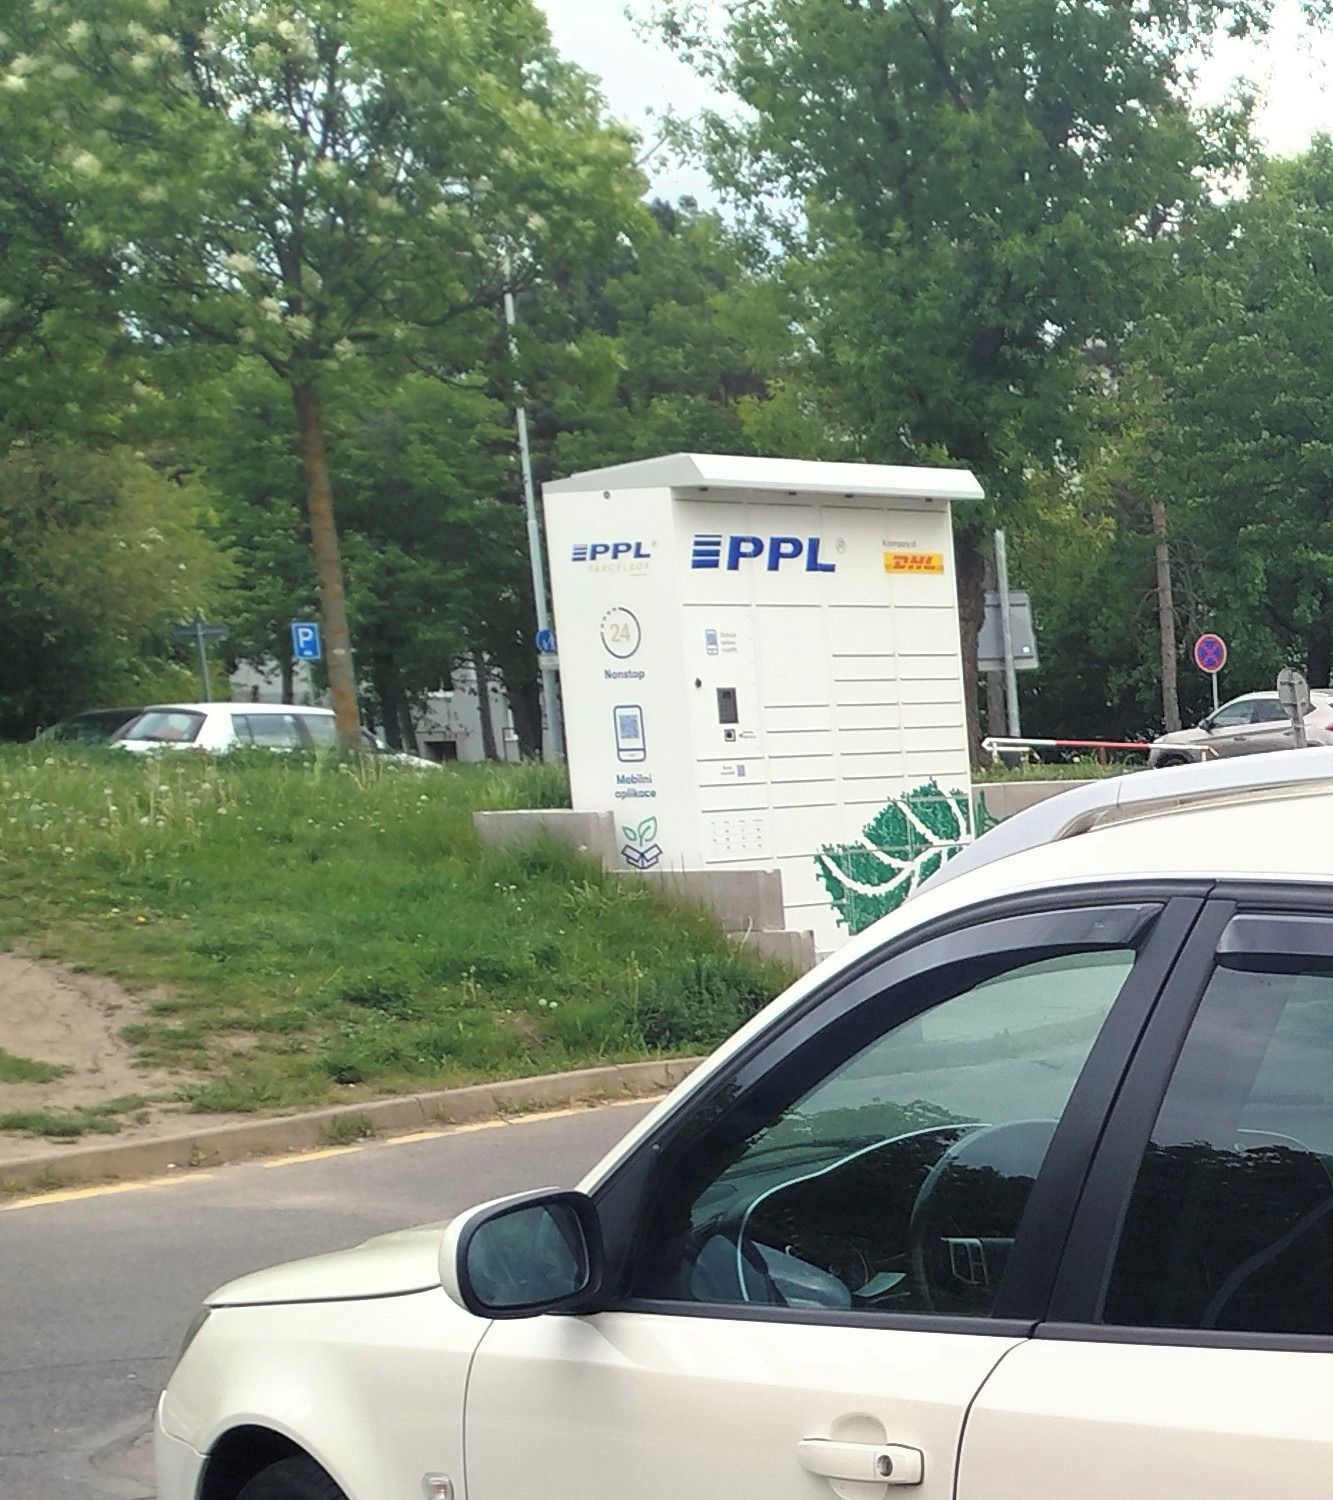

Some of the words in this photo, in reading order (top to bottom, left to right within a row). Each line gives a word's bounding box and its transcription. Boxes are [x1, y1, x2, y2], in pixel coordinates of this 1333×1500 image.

[590, 541, 651, 561] PPL
[726, 535, 836, 572] PPL
[892, 555, 936, 570] DHL
[297, 627, 314, 649] P
[609, 622, 631, 643] 24
[604, 669, 645, 681] Nonstop
